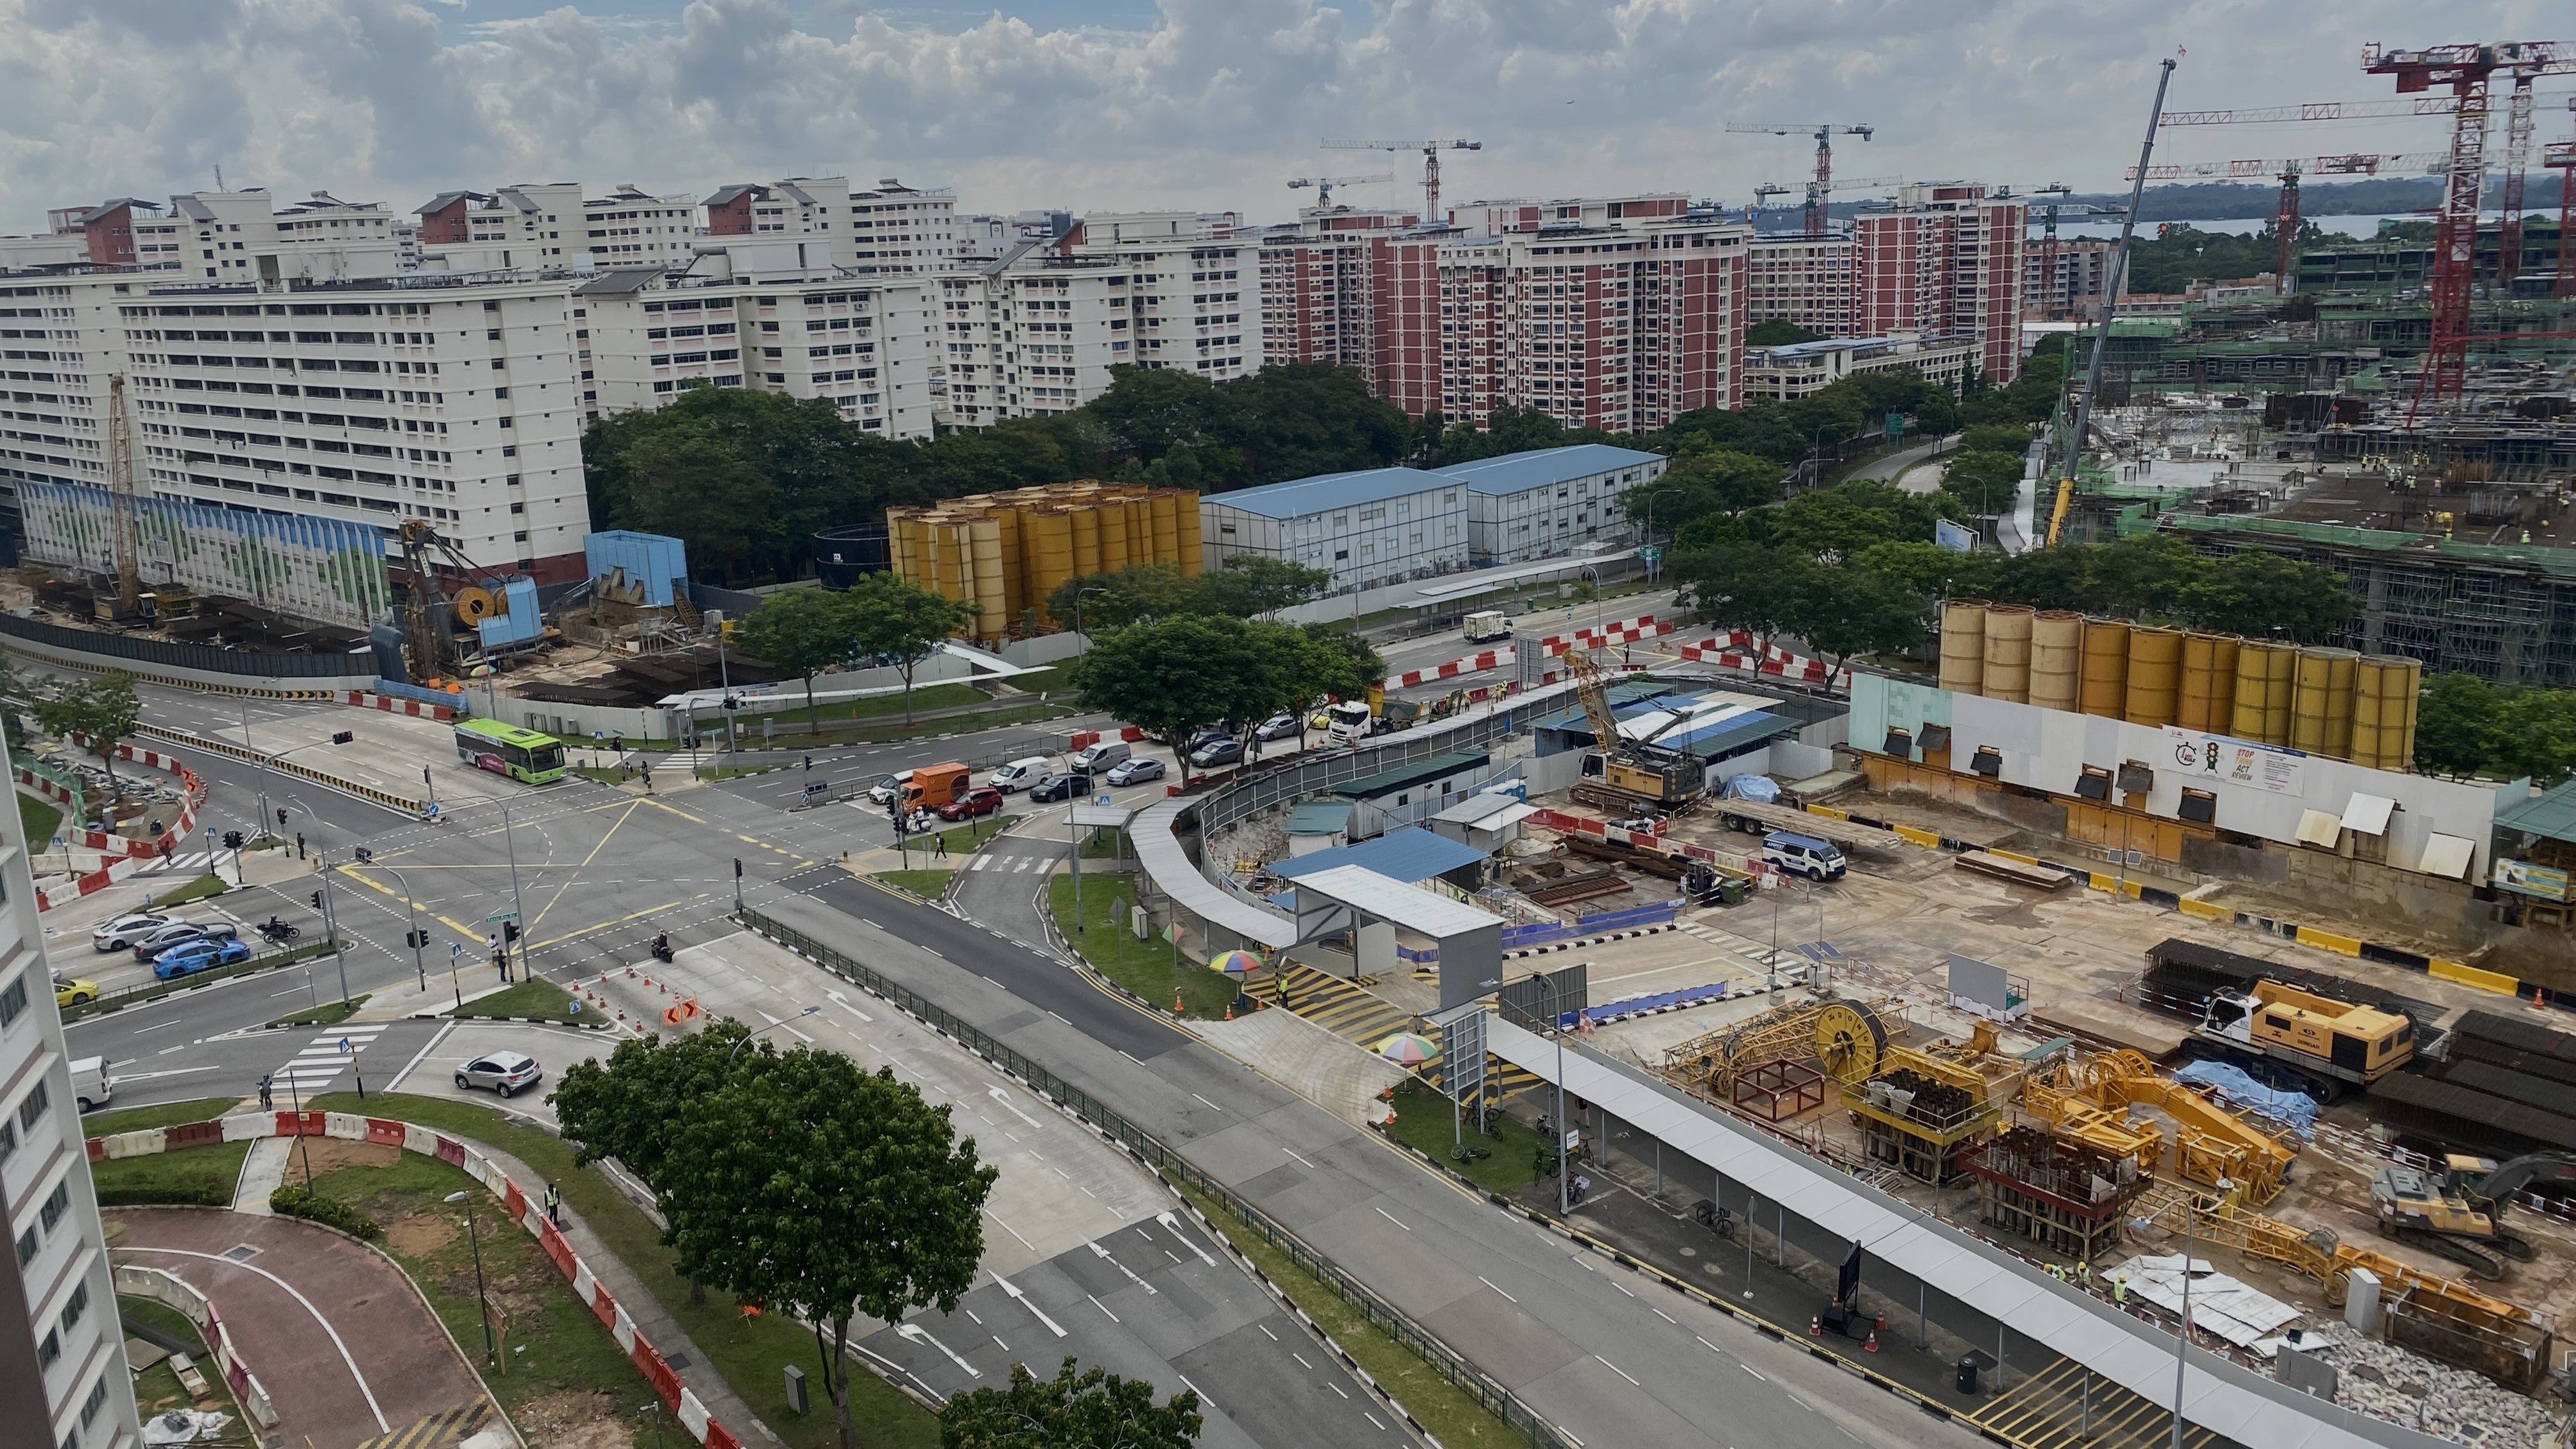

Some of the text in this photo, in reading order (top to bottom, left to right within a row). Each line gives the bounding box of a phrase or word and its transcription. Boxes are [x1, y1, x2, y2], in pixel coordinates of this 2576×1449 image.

[2237, 749, 2255, 758] STOP
[2235, 756, 2254, 766] THINK
[2236, 764, 2250, 773] ACT
[2232, 771, 2253, 781] REVIEW
